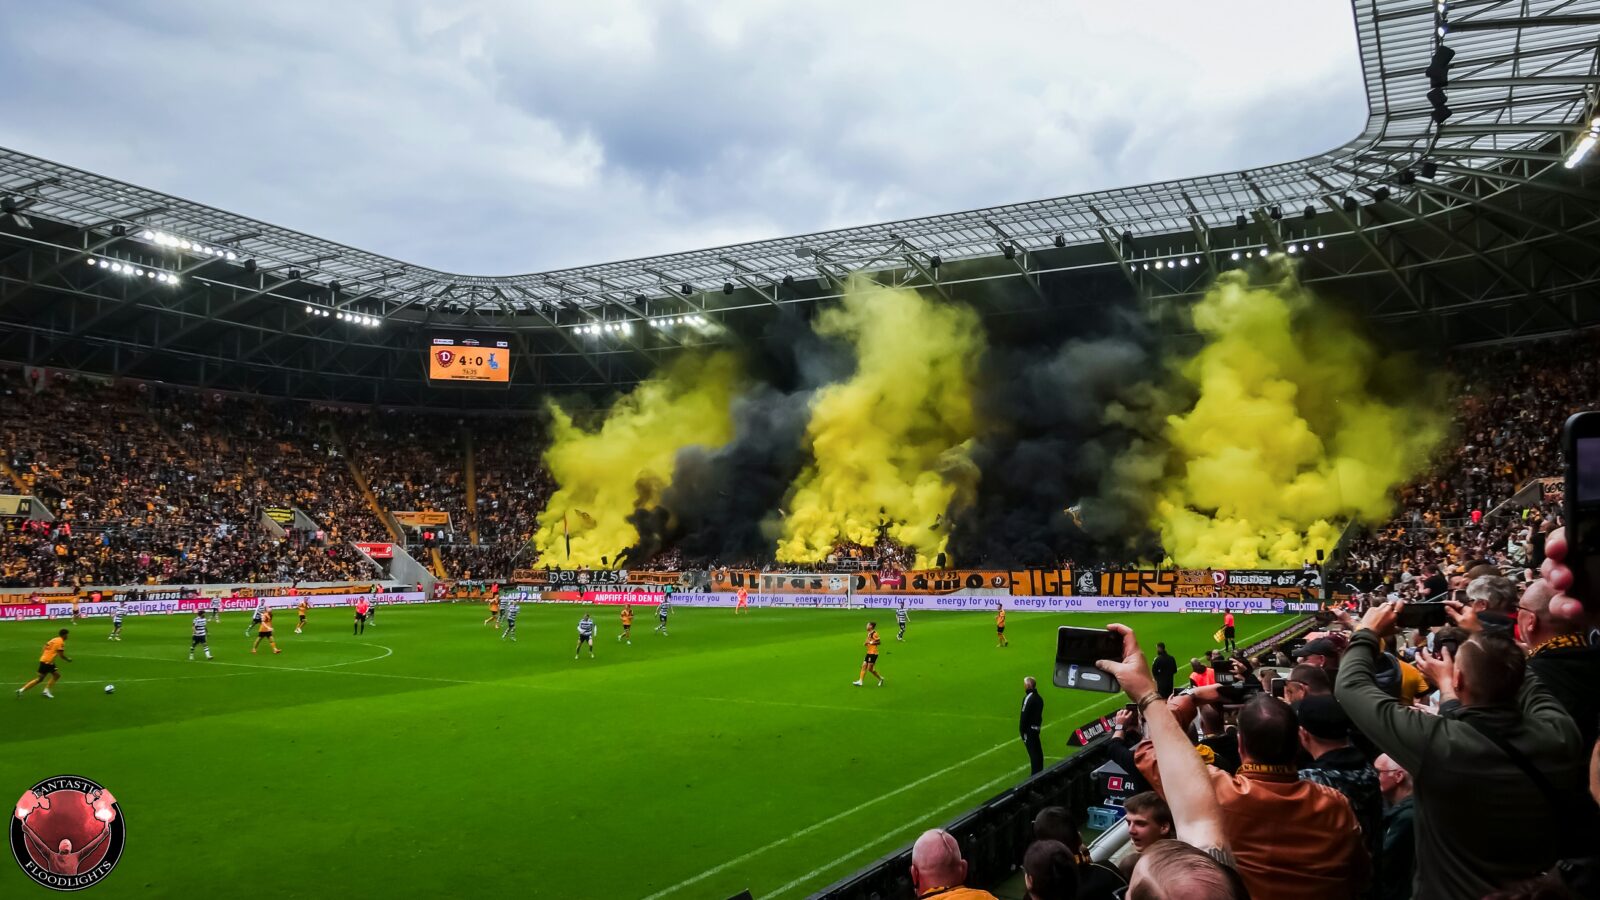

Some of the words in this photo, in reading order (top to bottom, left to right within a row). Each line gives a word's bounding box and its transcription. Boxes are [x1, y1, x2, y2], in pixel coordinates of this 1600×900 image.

[595, 593, 623, 603] ANPFIFF
[623, 592, 637, 602] FÜR
[639, 593, 653, 603] DEN
[694, 593, 706, 602] for
[707, 595, 720, 604] you
[757, 594, 769, 603] for
[771, 595, 784, 605] you
[795, 596, 821, 606] energy
[823, 595, 834, 604] for
[863, 596, 893, 606] energy
[894, 595, 906, 604] for
[908, 597, 924, 606] you
[936, 597, 967, 607] energy
[969, 595, 982, 605] for
[984, 597, 1001, 607] you
[1014, 598, 1046, 607] energy
[1049, 597, 1062, 606] for
[1065, 599, 1082, 608] you
[5, 606, 41, 617] Weine
[160, 601, 177, 611] her
[181, 602, 195, 610] ein
[224, 598, 256, 608] Gefühl!
[1096, 599, 1131, 609] energy
[1133, 598, 1150, 607] for
[1150, 599, 1169, 609] you
[1185, 599, 1221, 610] energy
[1224, 599, 1239, 608] for
[1242, 600, 1263, 610] you
